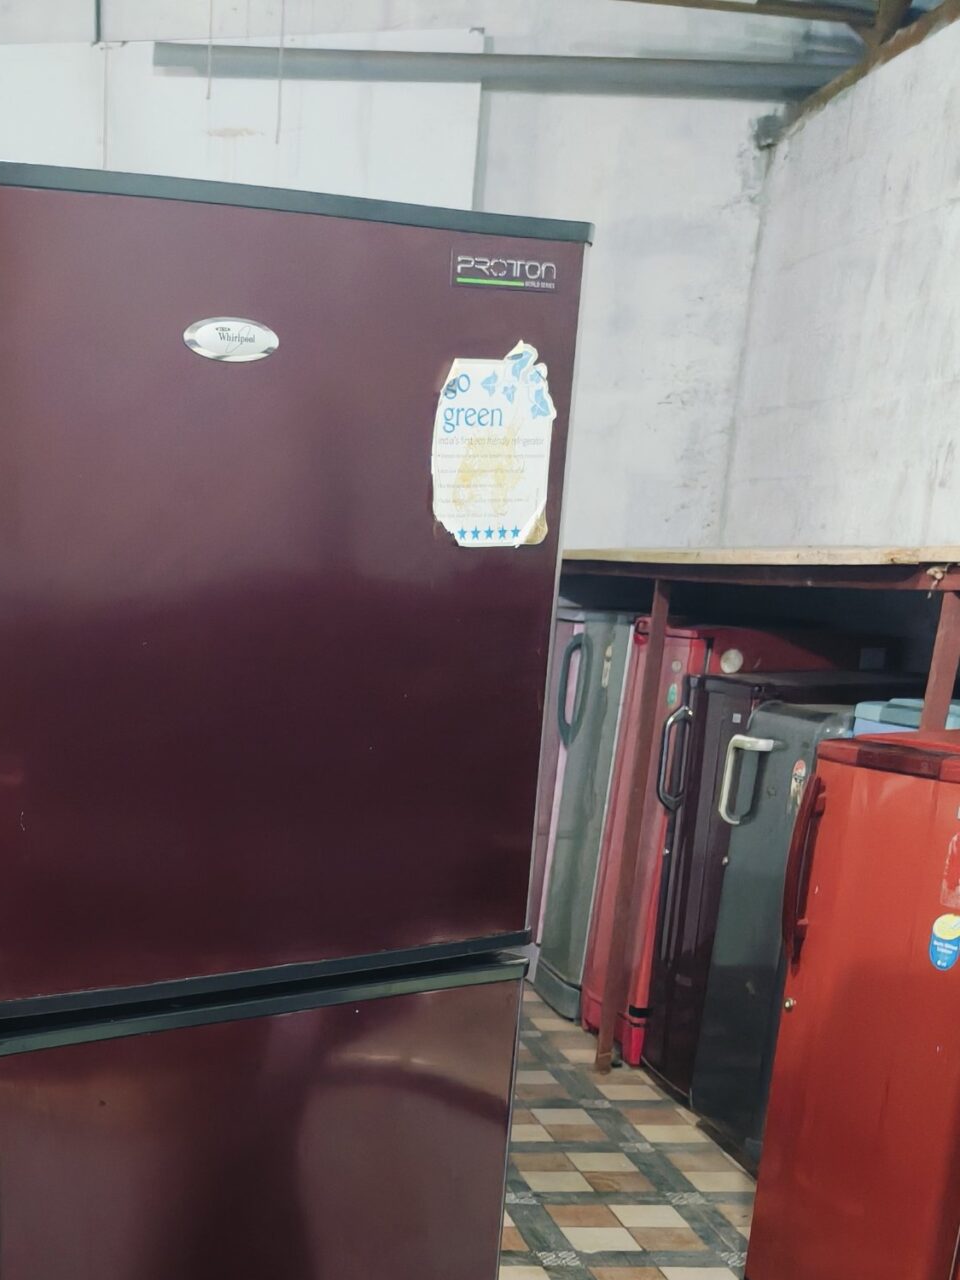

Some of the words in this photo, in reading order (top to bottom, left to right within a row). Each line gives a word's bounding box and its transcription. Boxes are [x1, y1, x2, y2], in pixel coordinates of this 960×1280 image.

[218, 332, 255, 345] Whirlpool
[444, 374, 470, 399] go
[443, 407, 503, 433] green
